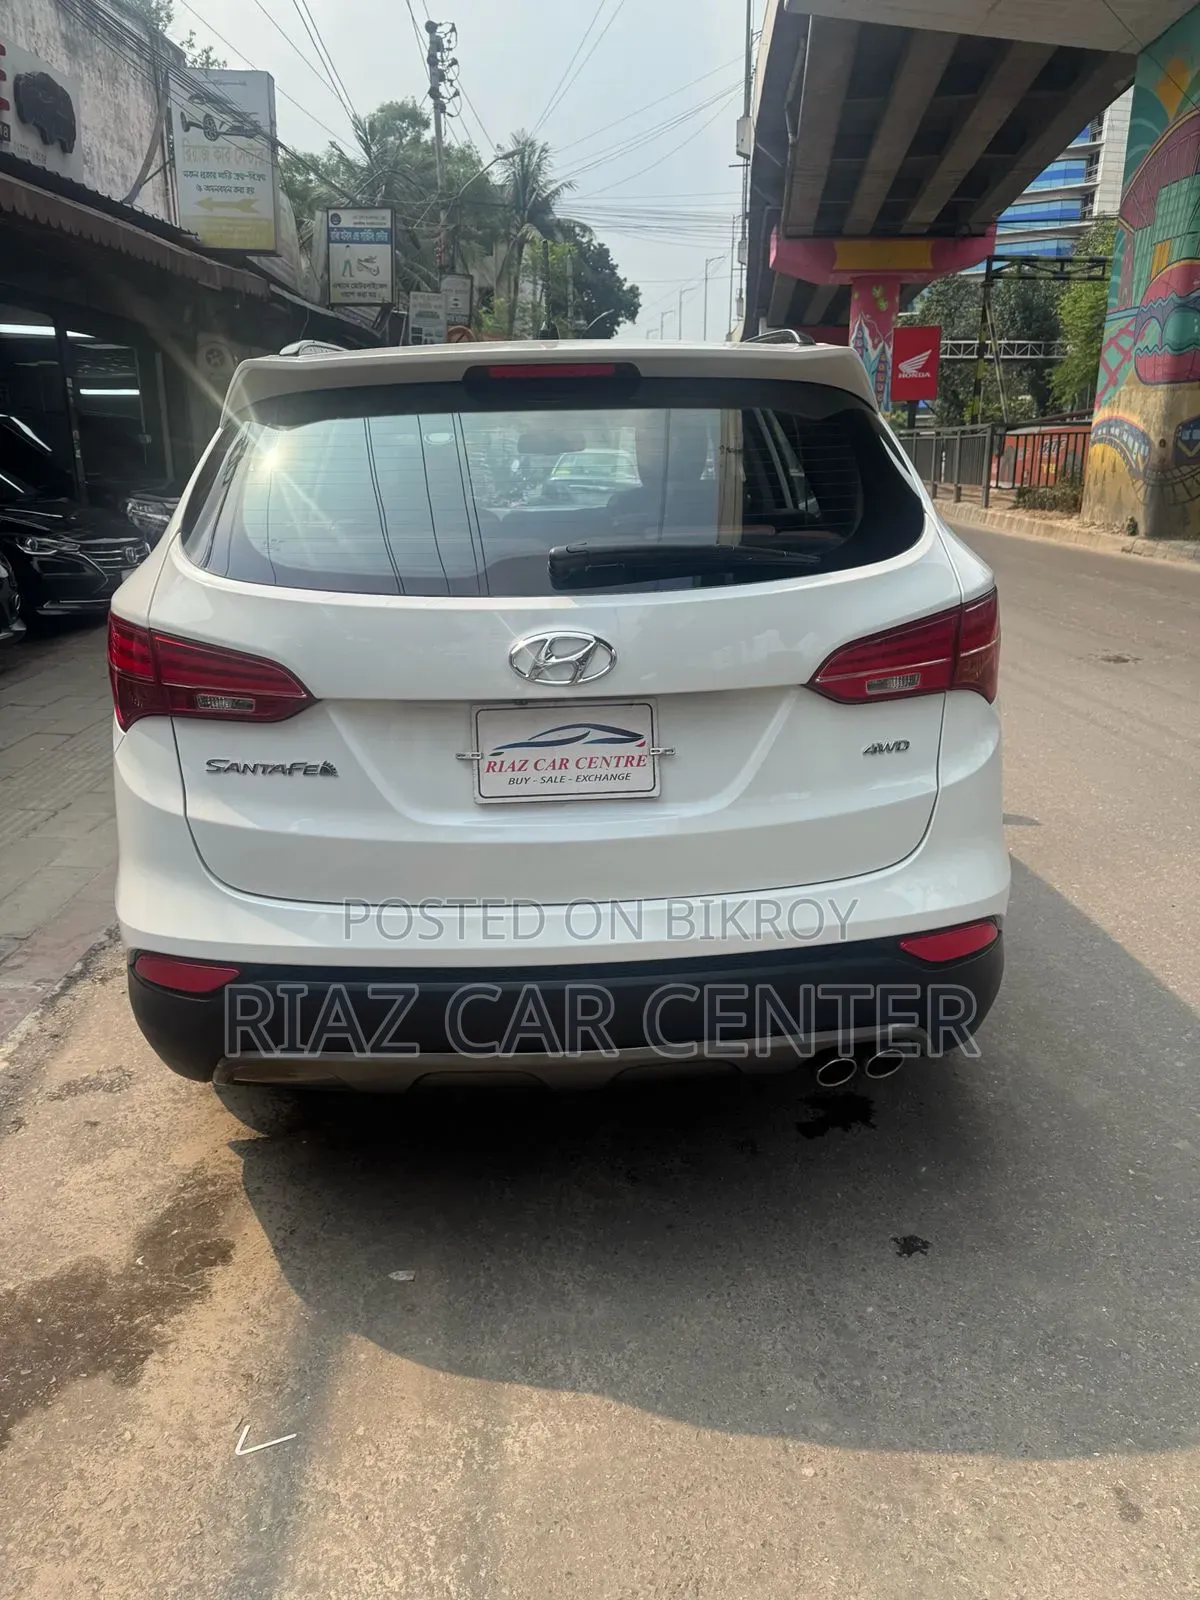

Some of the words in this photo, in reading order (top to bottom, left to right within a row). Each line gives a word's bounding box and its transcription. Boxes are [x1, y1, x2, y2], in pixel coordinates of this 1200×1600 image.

[862, 740, 910, 756] 4WD
[485, 759, 529, 773] RIAZ
[533, 757, 570, 772] CAR
[575, 754, 648, 770] CENTRE
[508, 776, 531, 785] BUY
[540, 775, 565, 784] SALE
[575, 773, 632, 783] EXCHANGE
